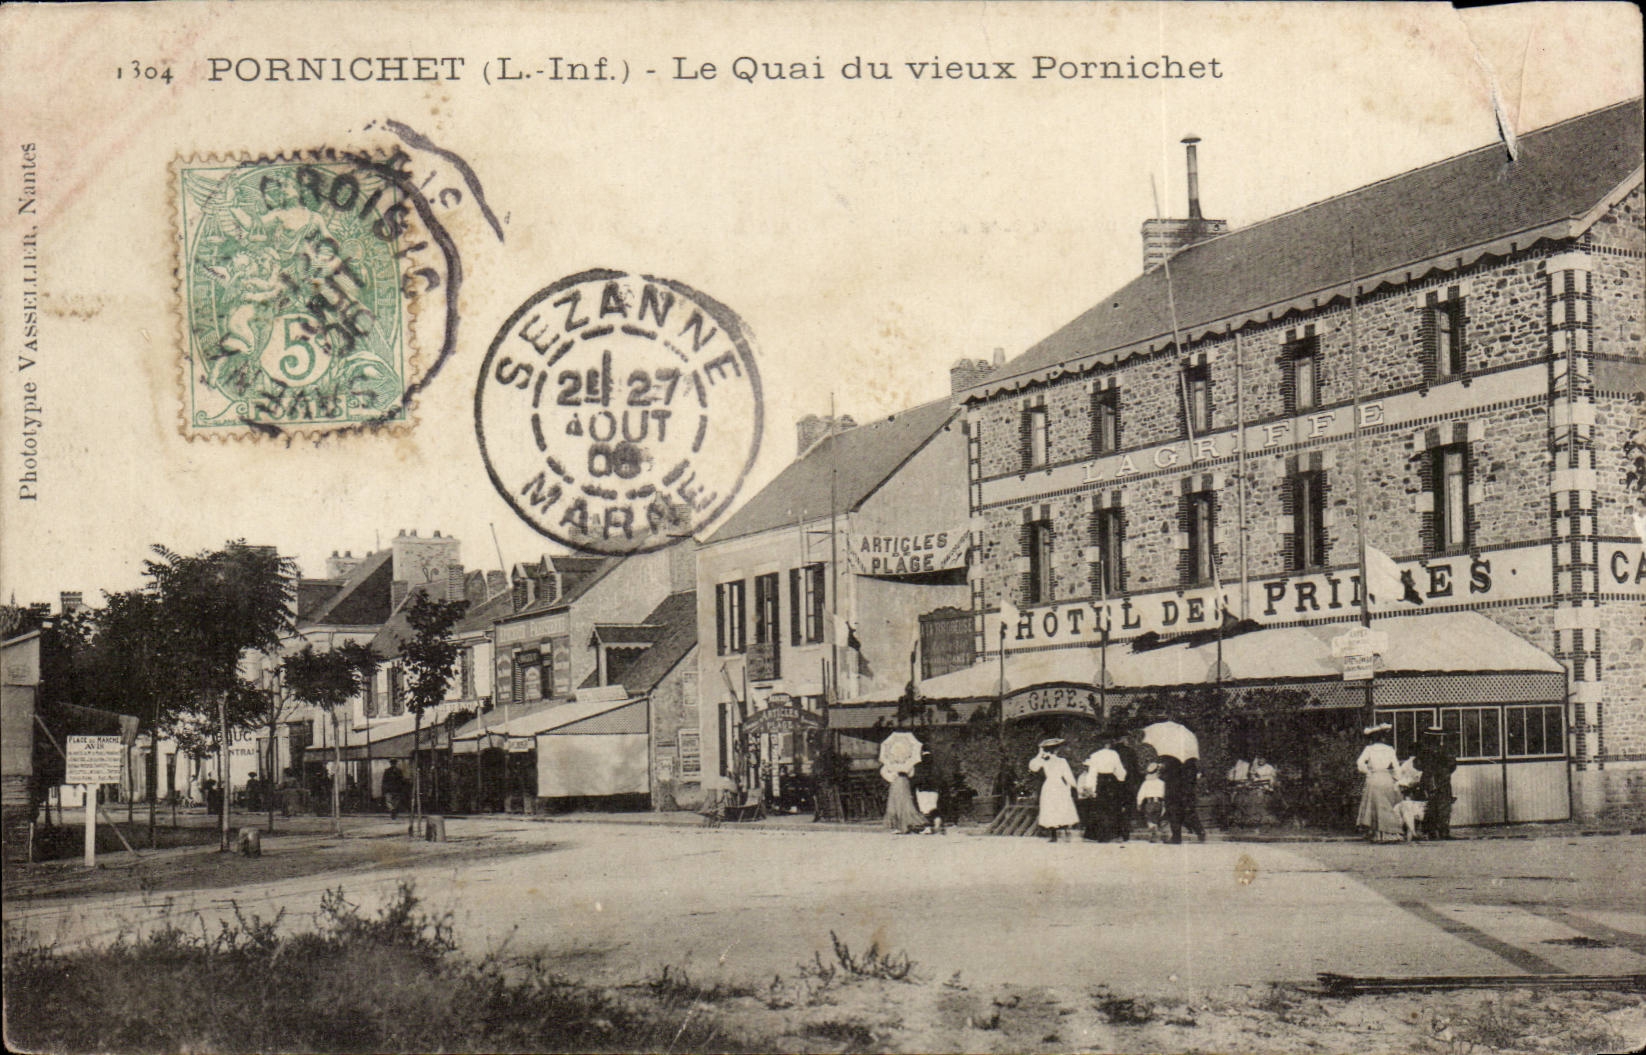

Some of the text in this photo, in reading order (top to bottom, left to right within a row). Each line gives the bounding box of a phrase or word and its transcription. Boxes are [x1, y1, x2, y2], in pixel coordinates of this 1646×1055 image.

[494, 281, 742, 389] SEZANNE
[626, 368, 681, 407] 27
[565, 410, 672, 443] AOUT
[861, 532, 948, 553] ARTICLES
[872, 553, 934, 574] PLAGE
[1263, 558, 1492, 616] PRIES
